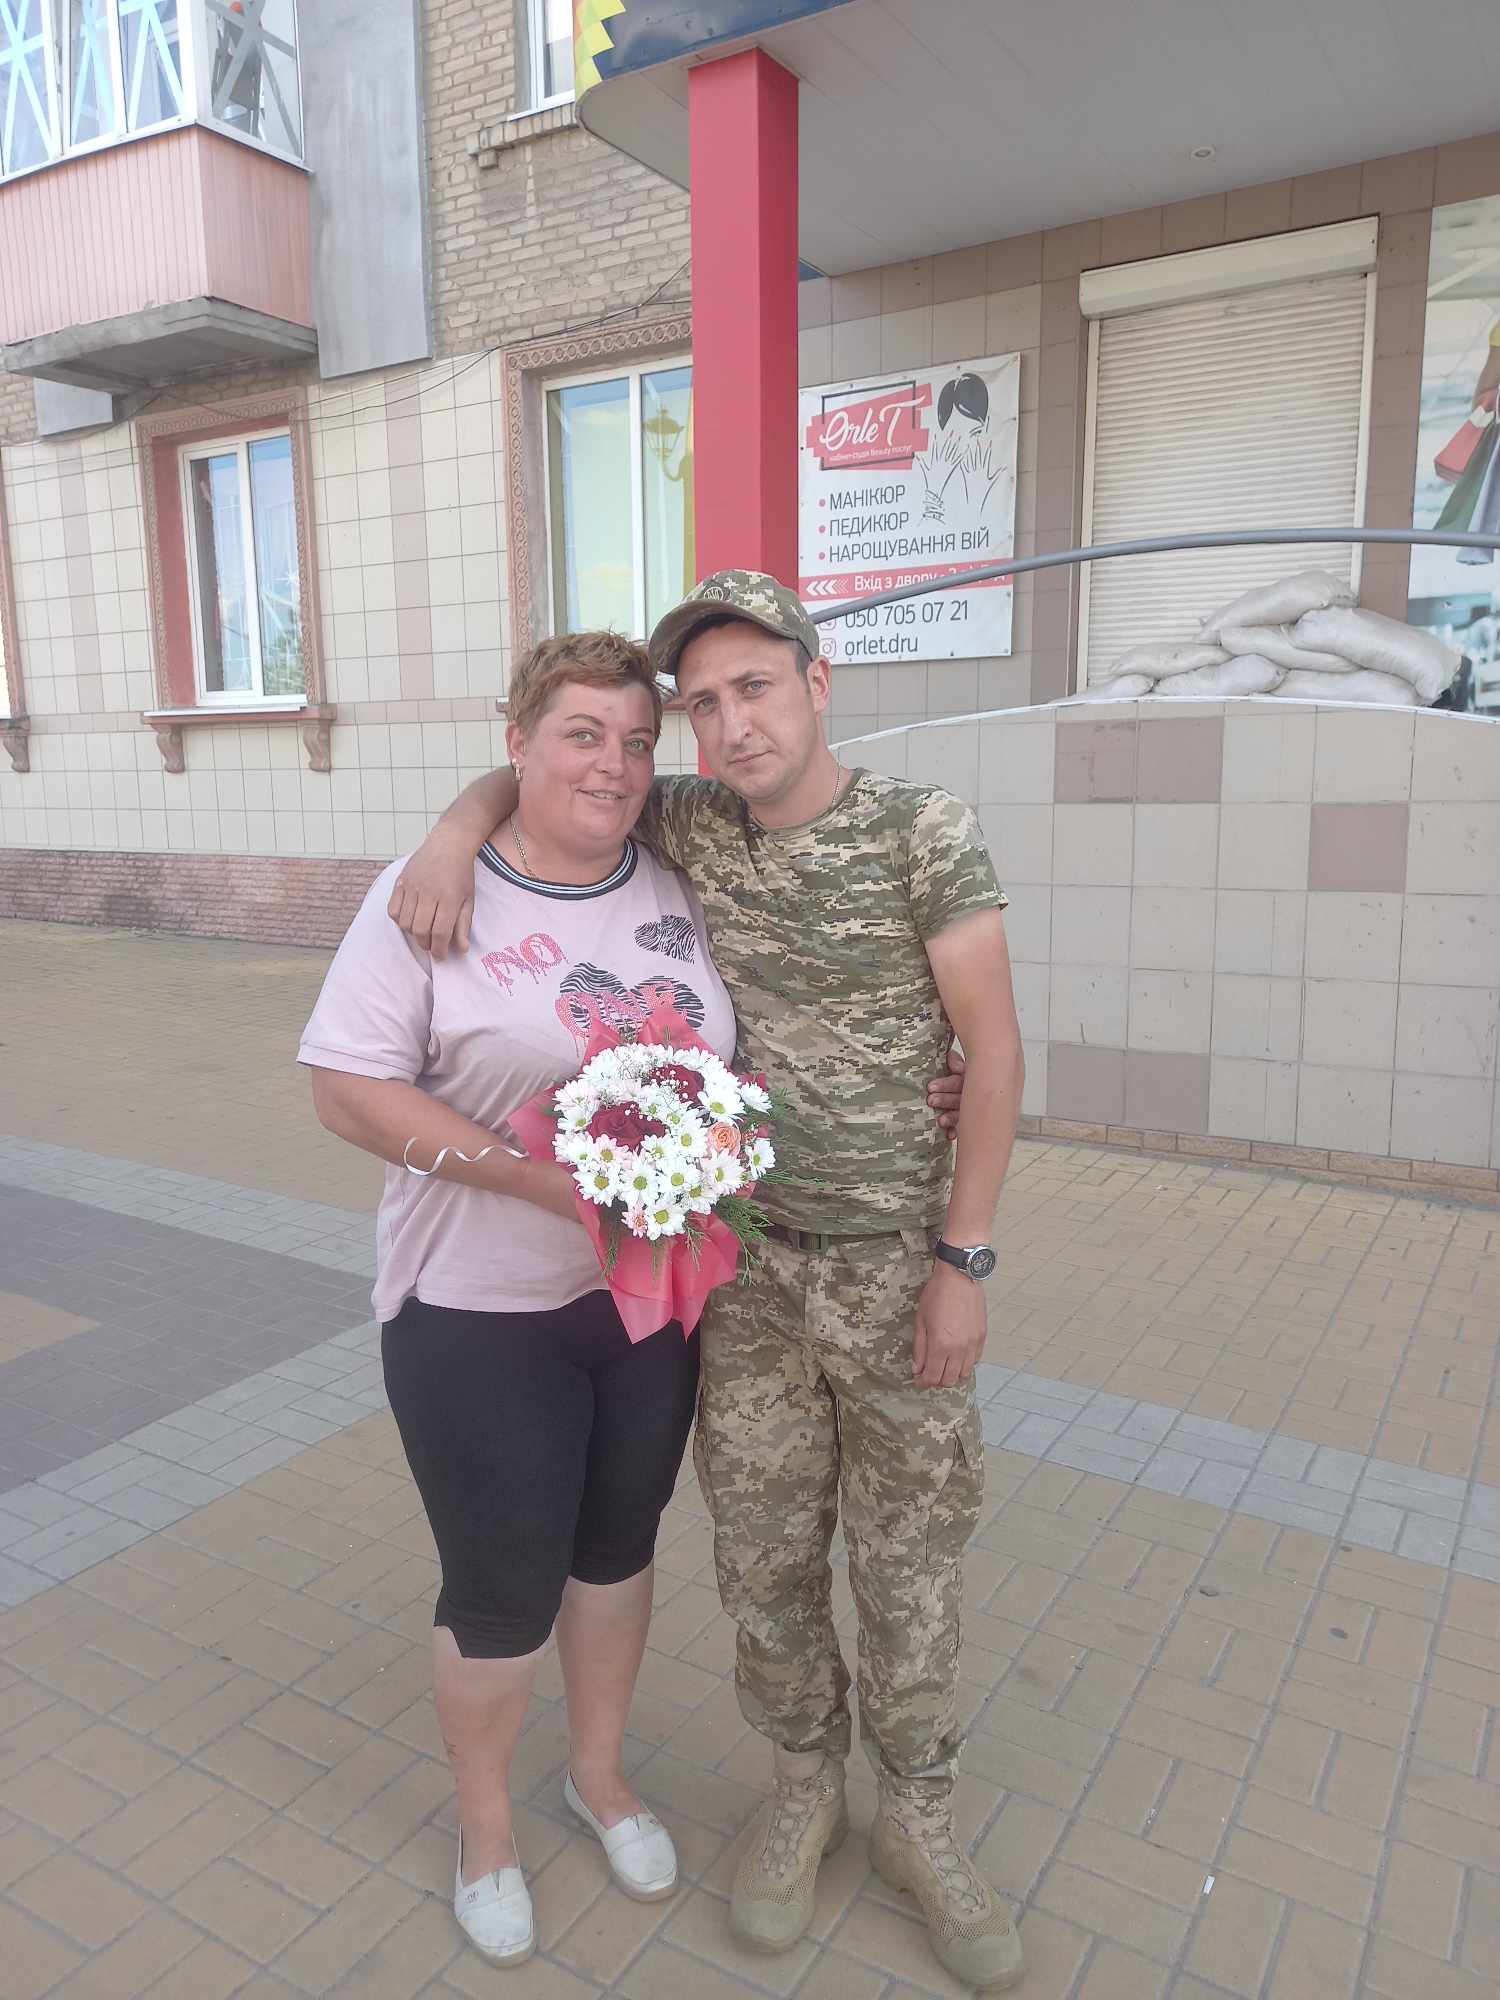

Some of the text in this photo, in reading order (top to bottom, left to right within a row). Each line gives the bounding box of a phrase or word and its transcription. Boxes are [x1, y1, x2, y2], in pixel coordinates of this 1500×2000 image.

[829, 485, 905, 510] МАНІКЮР
[829, 512, 909, 538] ПЕДИКЮР
[829, 526, 989, 563] НАРОЩУВАННЯ ВІЙ
[854, 574, 882, 592] Вхід
[845, 599, 968, 628] 050 705 07 21
[845, 633, 918, 656] orlet.dru
